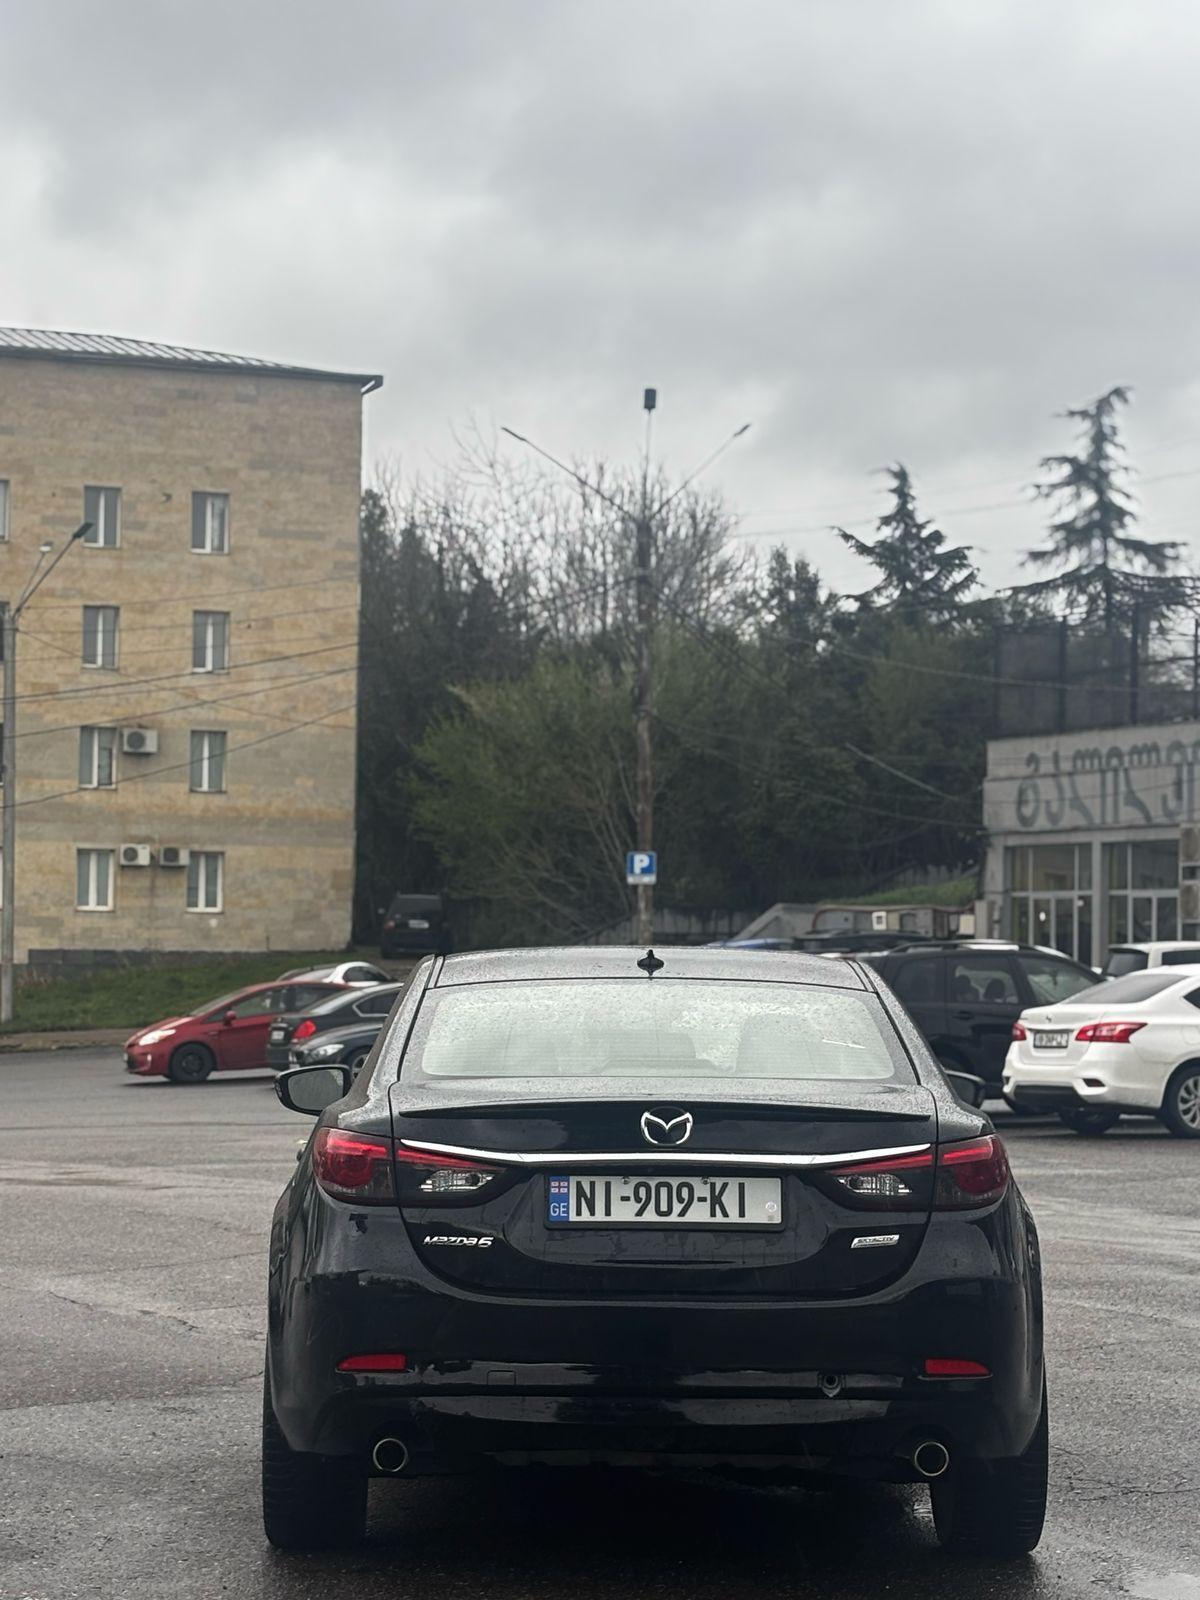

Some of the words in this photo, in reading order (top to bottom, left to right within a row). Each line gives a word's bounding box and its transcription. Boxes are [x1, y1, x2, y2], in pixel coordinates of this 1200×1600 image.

[633, 853, 650, 875] P
[550, 1202, 568, 1217] GE
[575, 1180, 746, 1218] NI-909-KI
